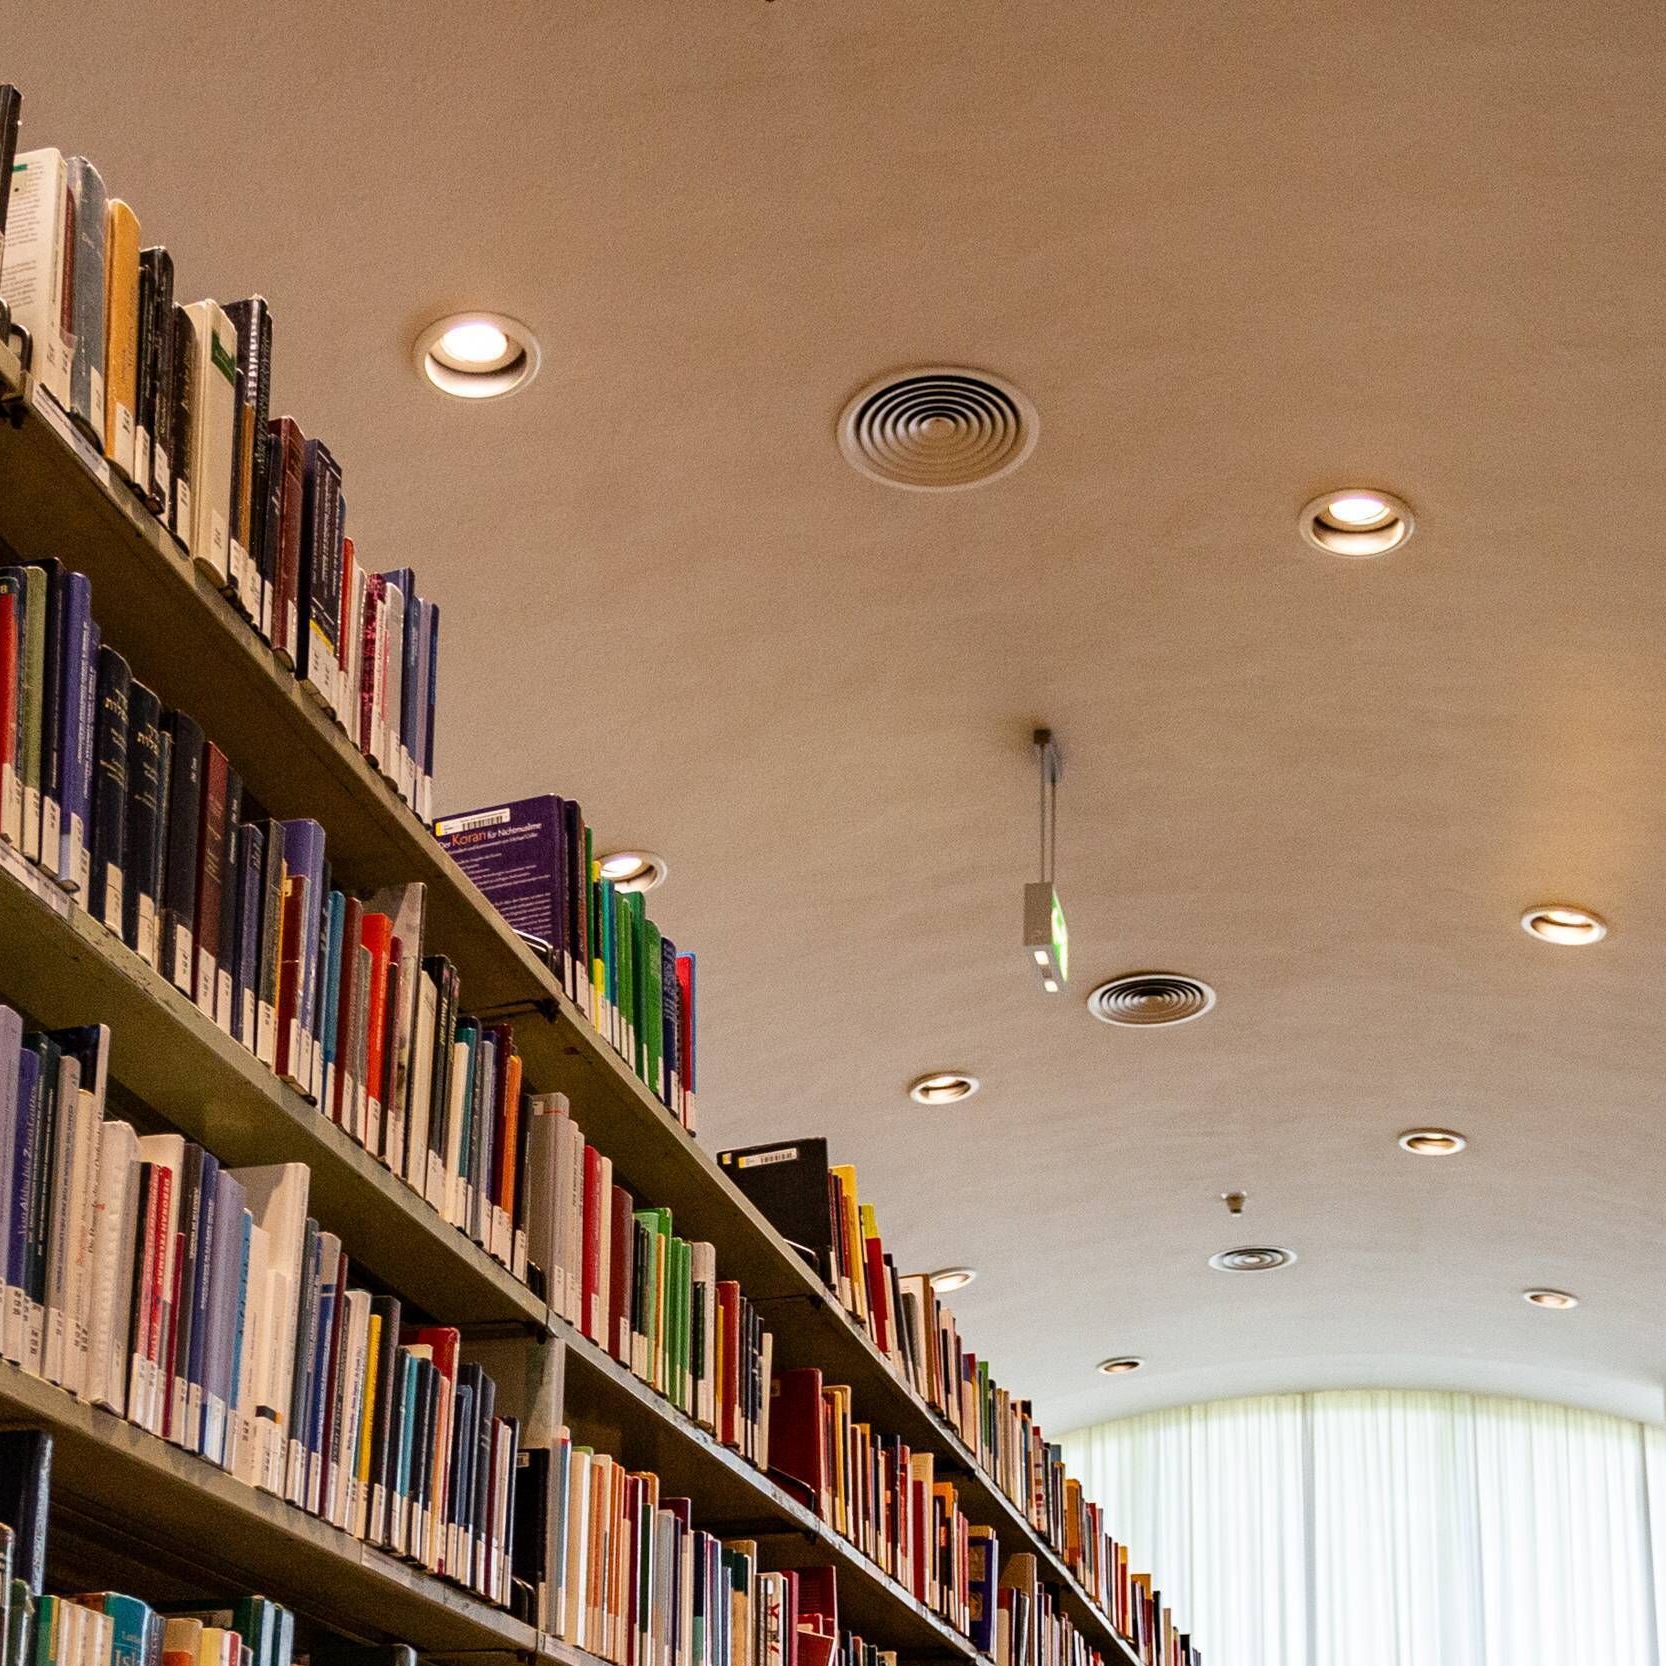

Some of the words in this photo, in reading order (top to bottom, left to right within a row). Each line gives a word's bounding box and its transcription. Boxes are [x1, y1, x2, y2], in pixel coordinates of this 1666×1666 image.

[448, 825, 487, 851] Koran
[497, 820, 543, 836] Nichtmuslime
[159, 1177, 172, 1231] DEBORAH
[154, 1233, 167, 1285] FELDMAN
